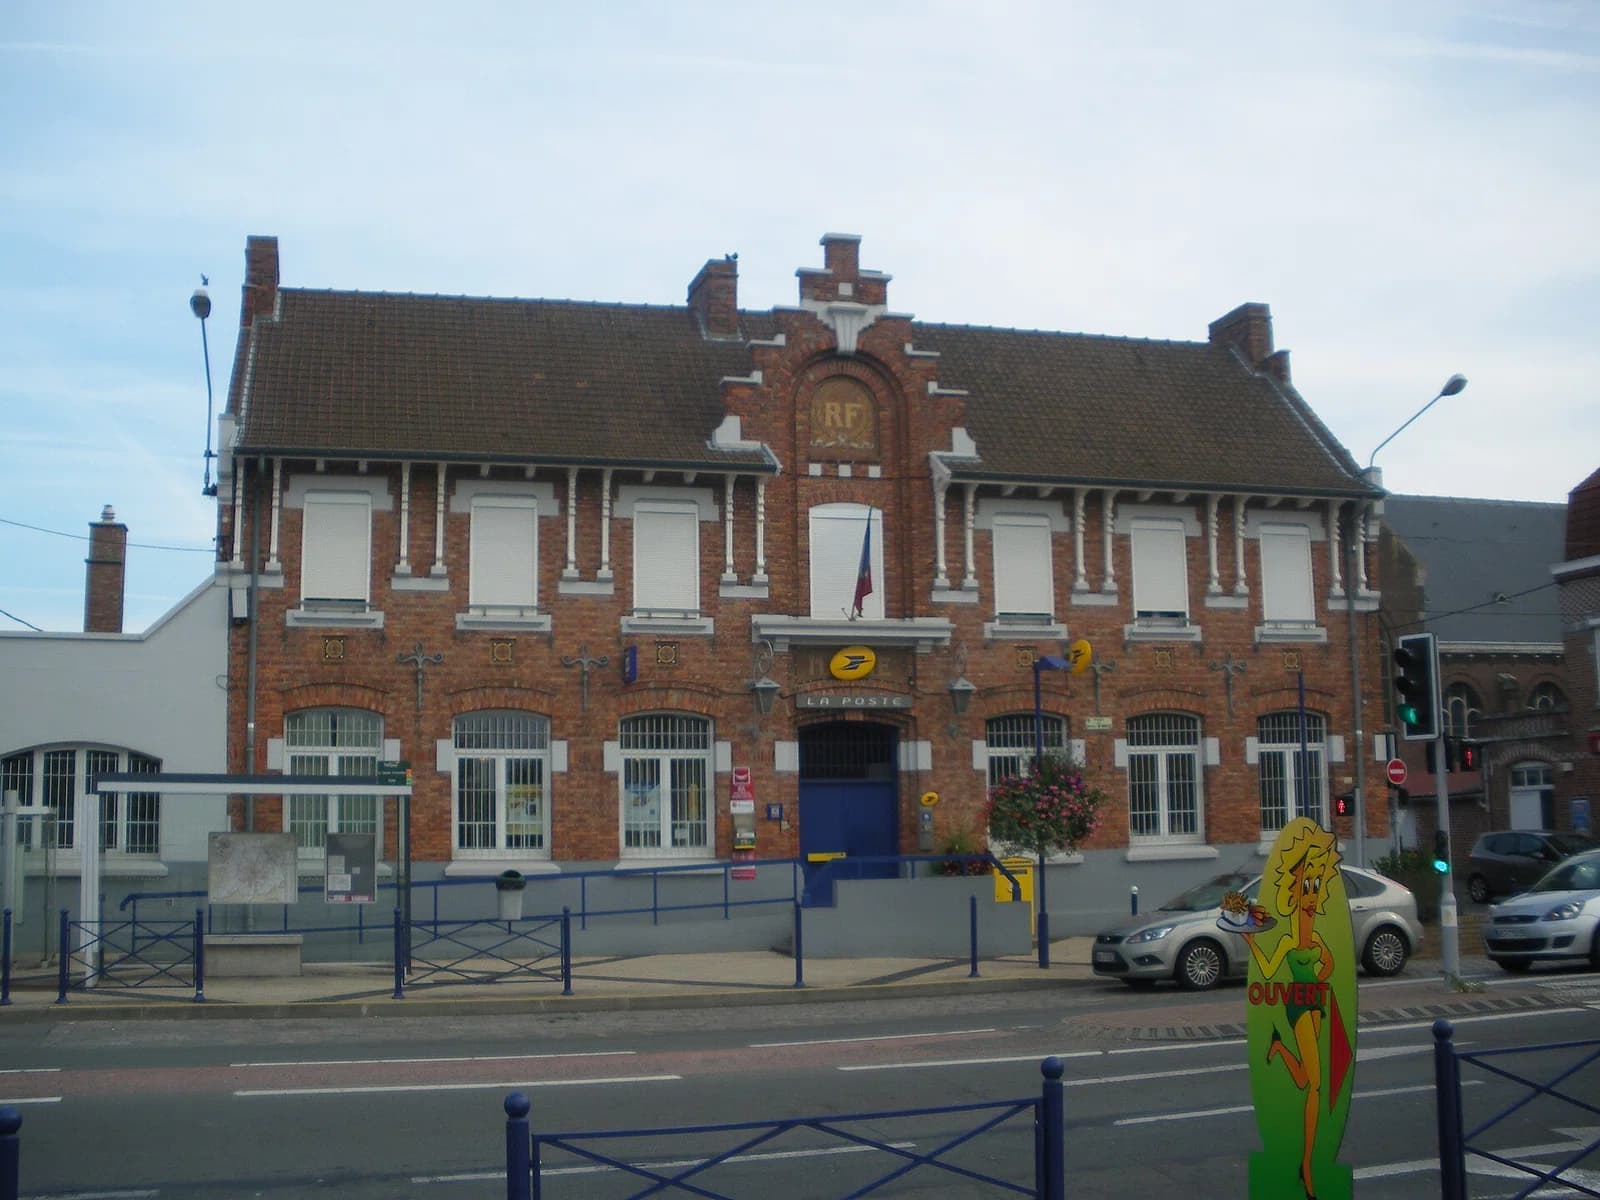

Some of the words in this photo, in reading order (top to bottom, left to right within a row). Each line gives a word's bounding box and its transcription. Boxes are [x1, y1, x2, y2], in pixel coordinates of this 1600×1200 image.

[824, 402, 865, 428] RF
[807, 696, 829, 706] LA
[841, 696, 903, 706] POSTE
[1248, 982, 1330, 1006] OUVERT
